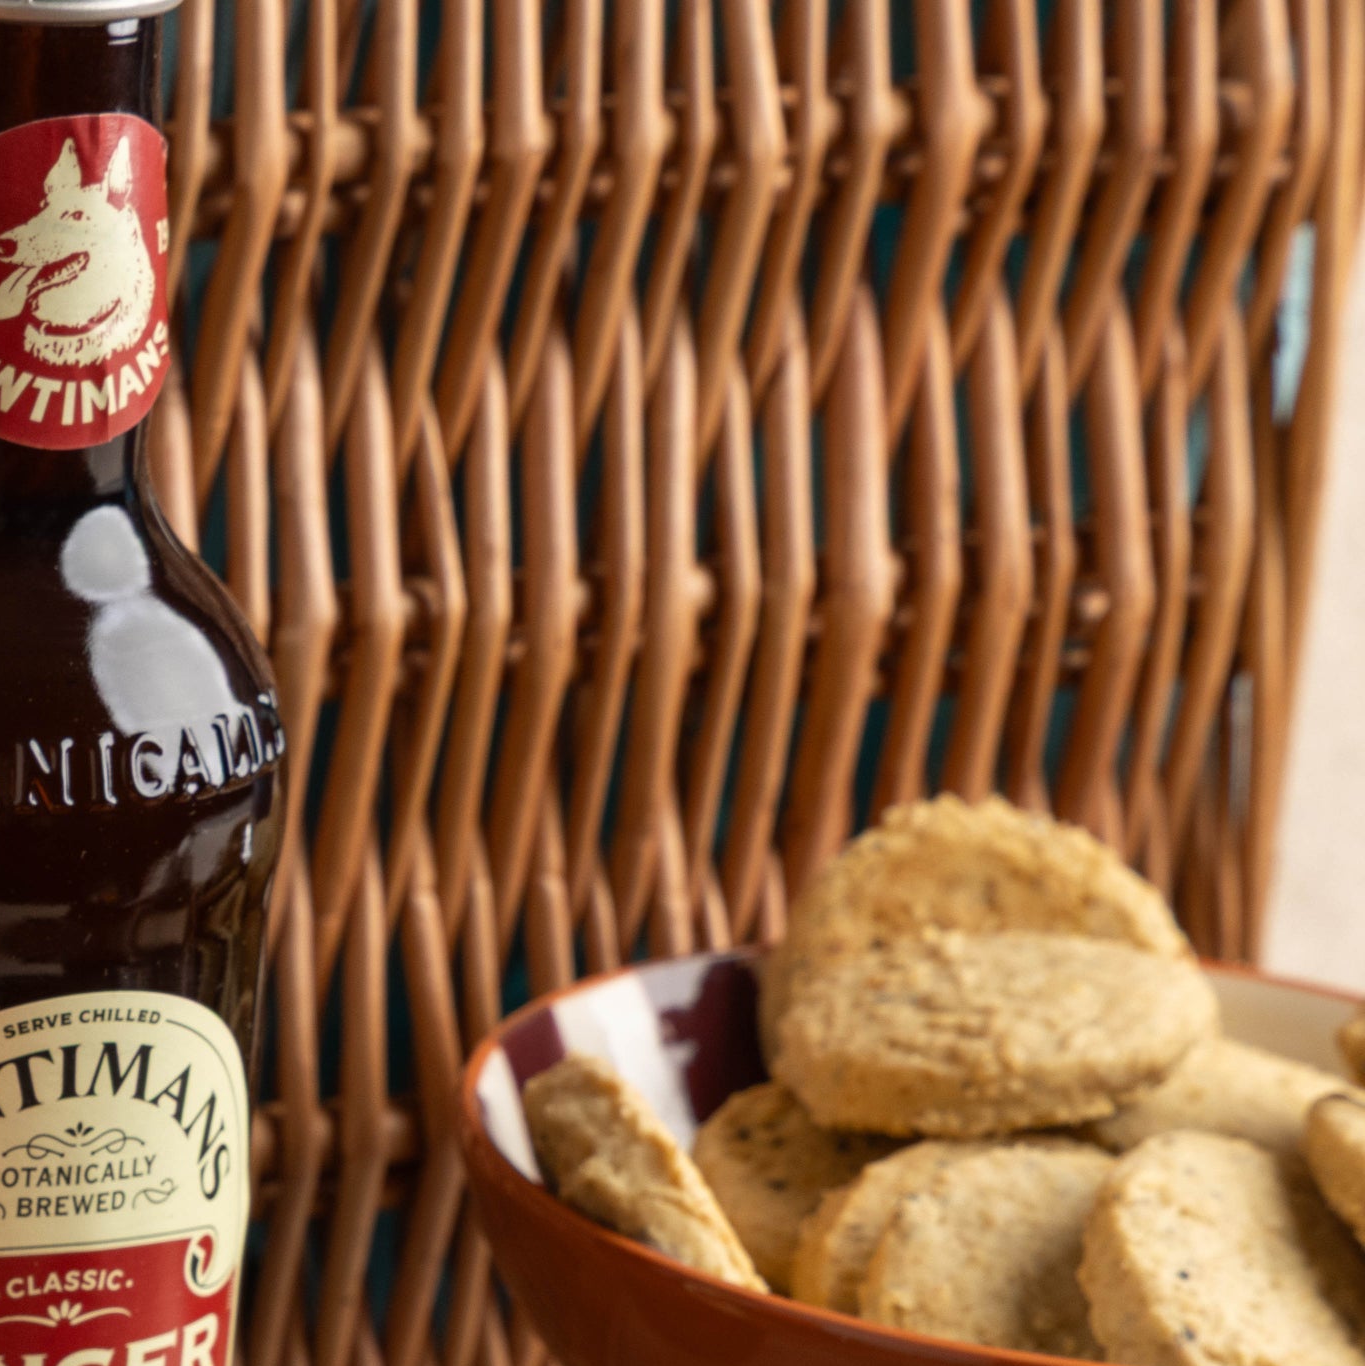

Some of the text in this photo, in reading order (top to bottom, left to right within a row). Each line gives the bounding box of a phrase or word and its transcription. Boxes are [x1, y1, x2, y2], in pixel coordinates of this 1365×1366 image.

[3, 1008, 161, 1039] SERVE CHILLED
[16, 1191, 126, 1219] BREWED
